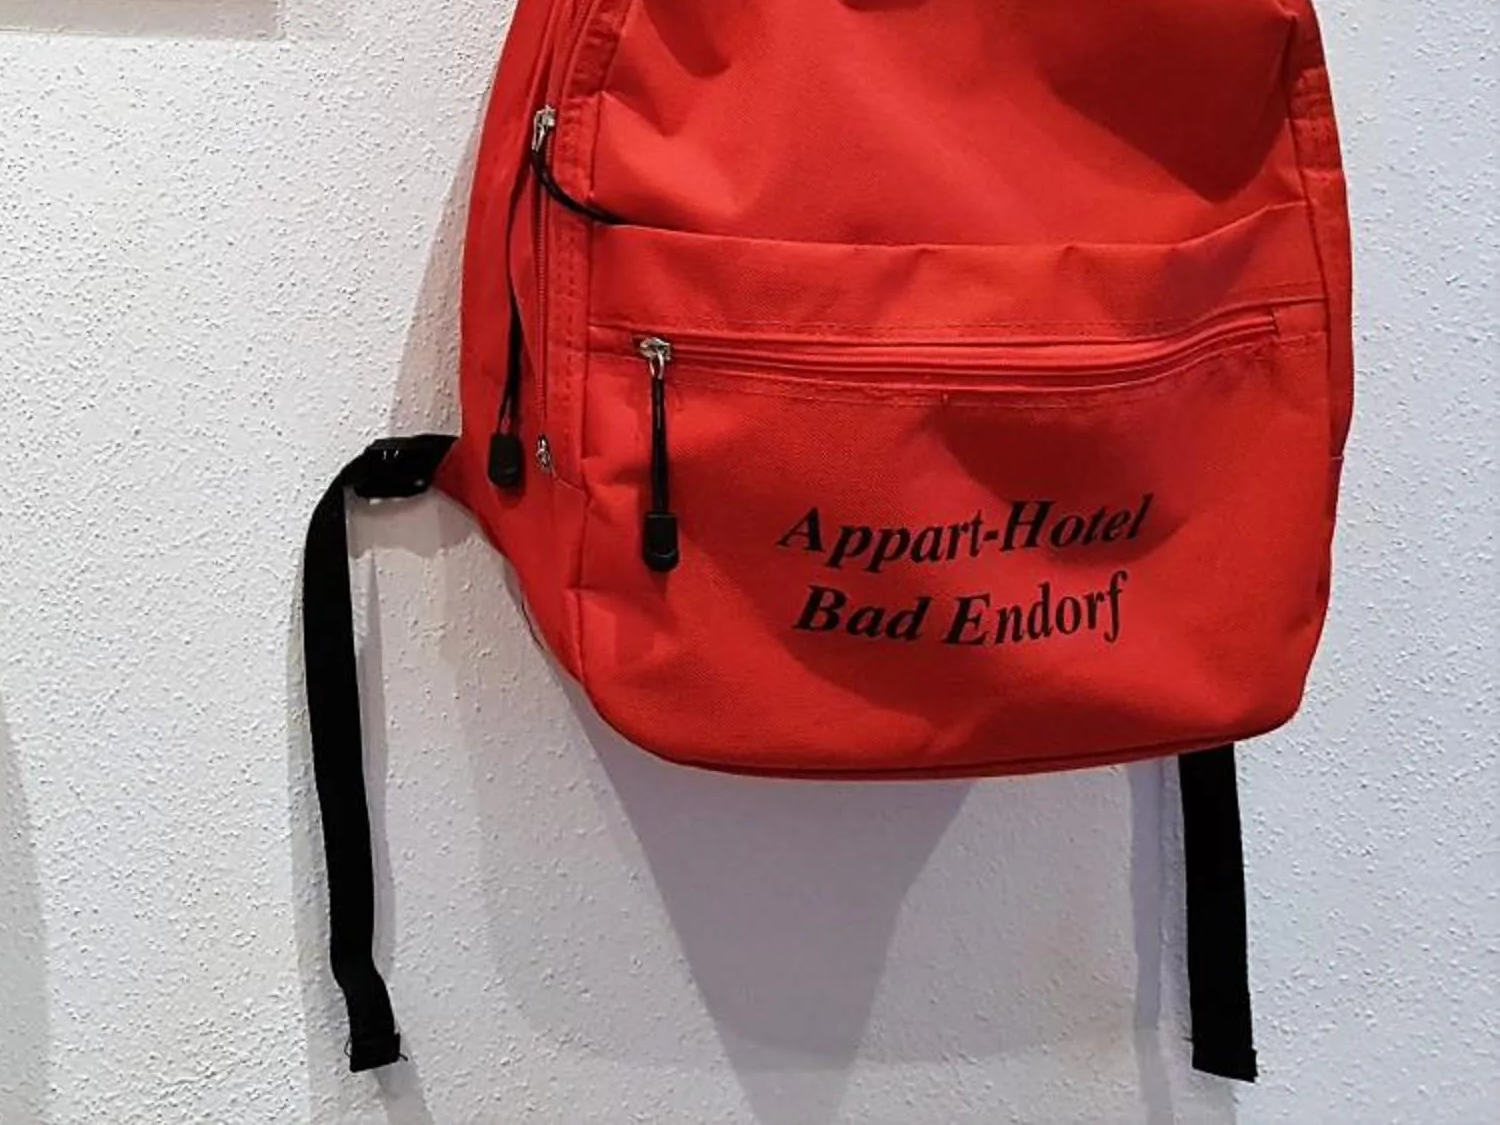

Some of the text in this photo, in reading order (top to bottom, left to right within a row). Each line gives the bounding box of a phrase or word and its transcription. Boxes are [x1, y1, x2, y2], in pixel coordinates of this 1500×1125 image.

[775, 492, 1155, 574] Appart-Hotel
[792, 570, 1129, 646] Bad Endorf
